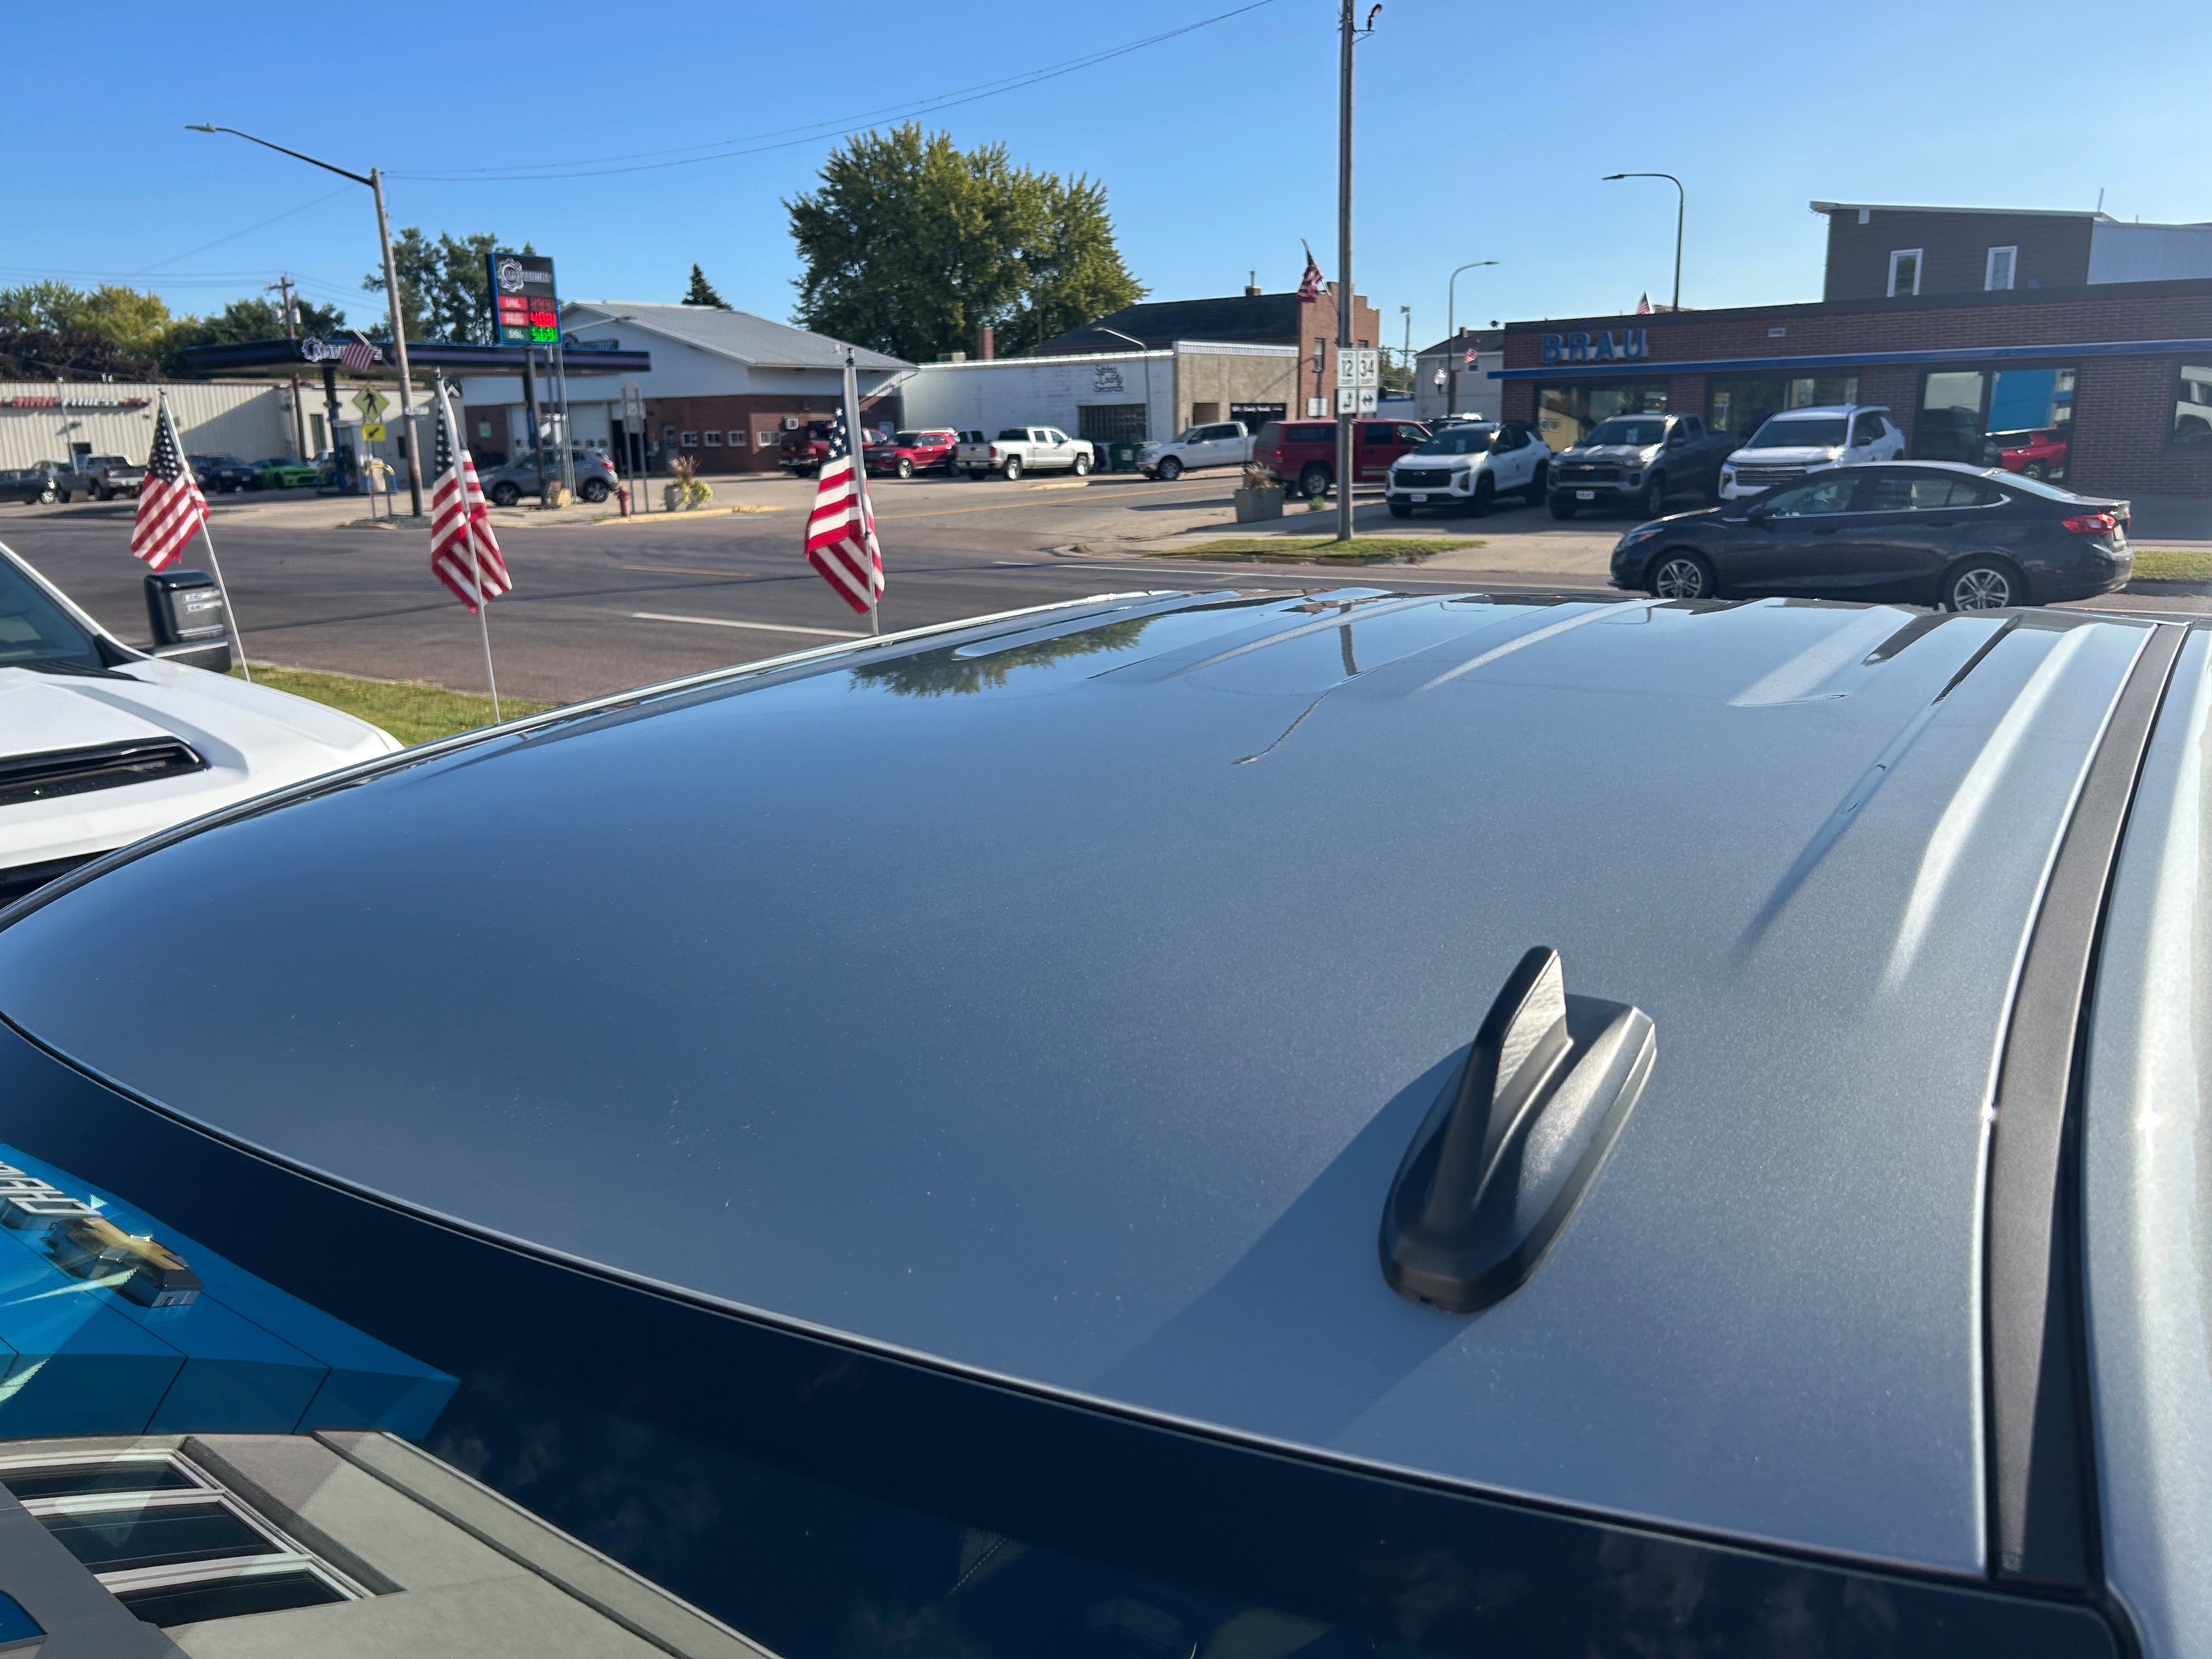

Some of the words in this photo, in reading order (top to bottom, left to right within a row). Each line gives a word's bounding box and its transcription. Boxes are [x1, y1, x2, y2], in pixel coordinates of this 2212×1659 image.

[1542, 329, 1646, 363] BRAU
[1341, 359, 1353, 377] 12
[1360, 359, 1374, 377] 34
